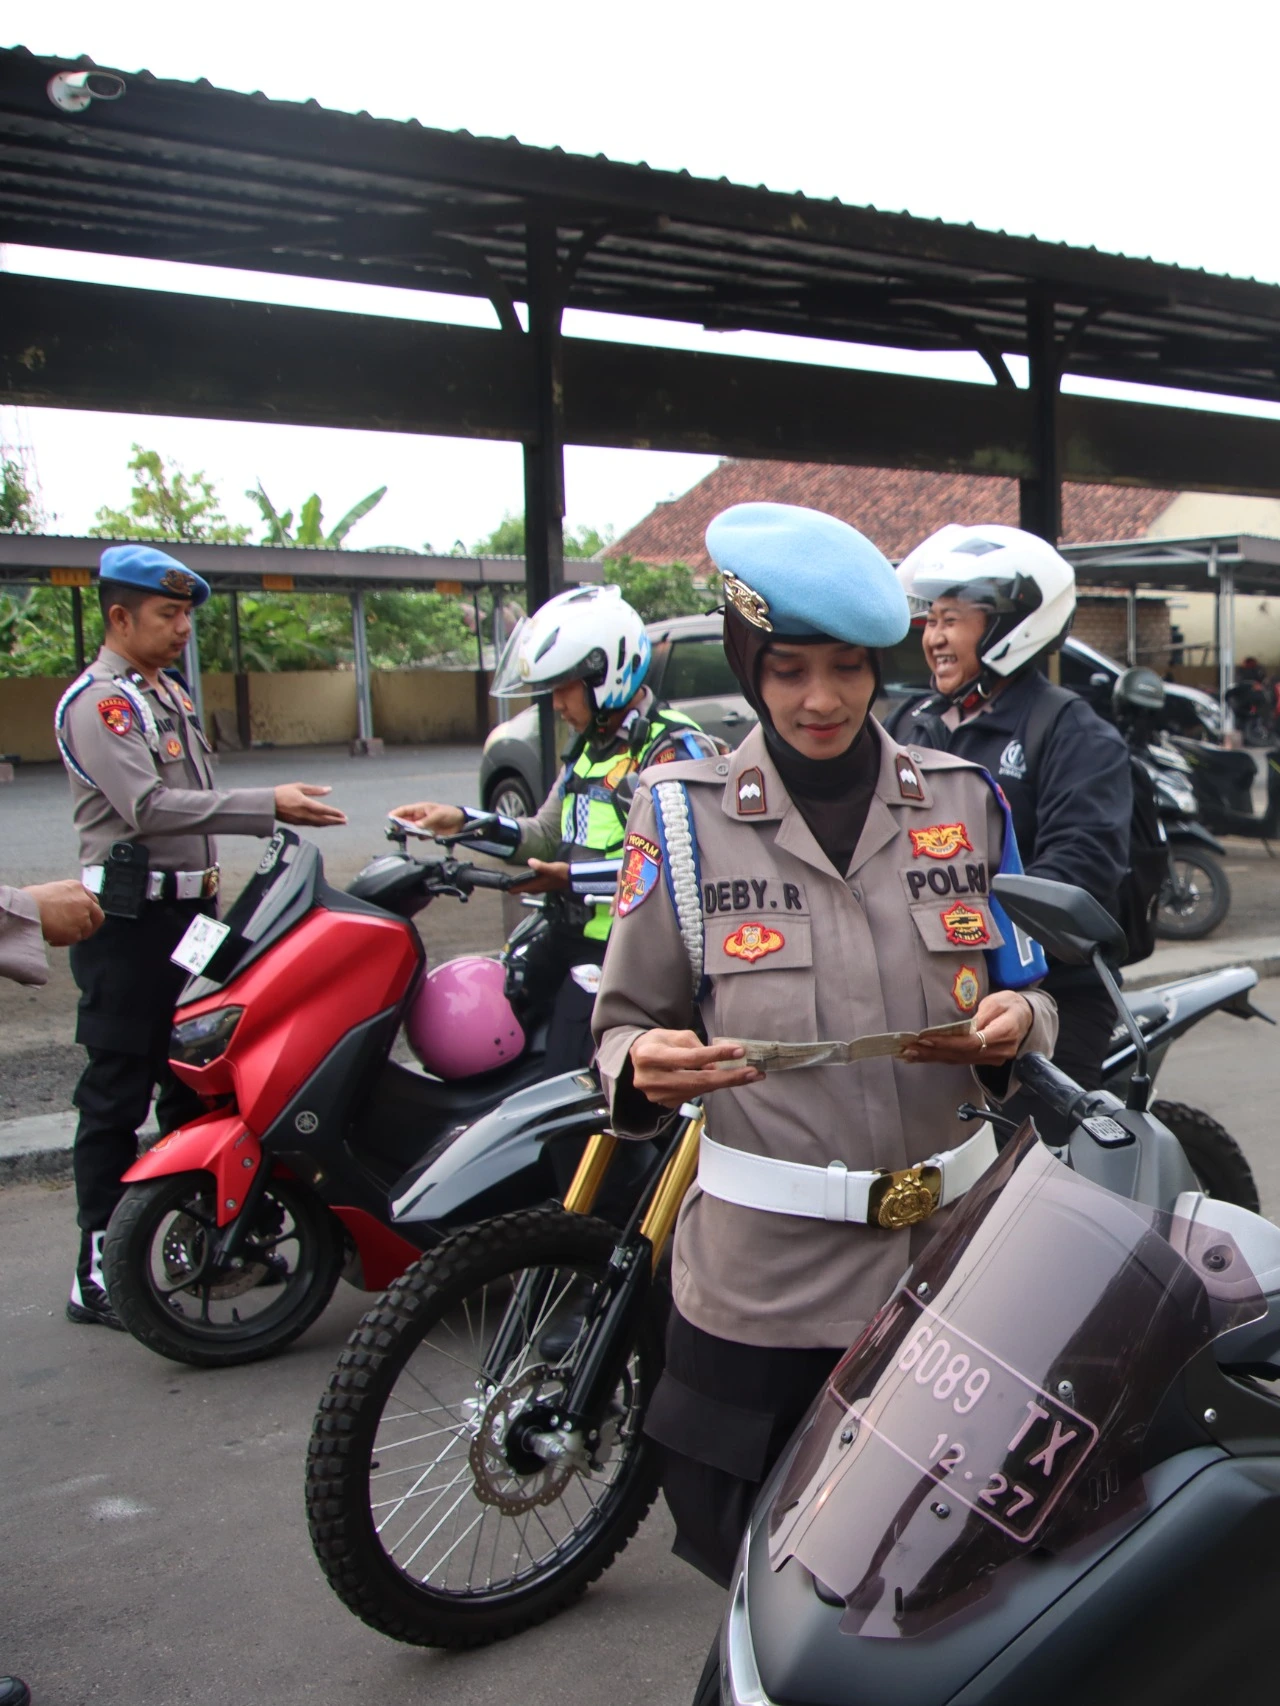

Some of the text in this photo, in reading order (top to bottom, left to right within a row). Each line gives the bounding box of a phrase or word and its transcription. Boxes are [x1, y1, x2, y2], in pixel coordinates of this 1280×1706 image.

[906, 862, 987, 899] POLRI
[899, 1326, 991, 1414] 6089
[1008, 1401, 1078, 1476] TX
